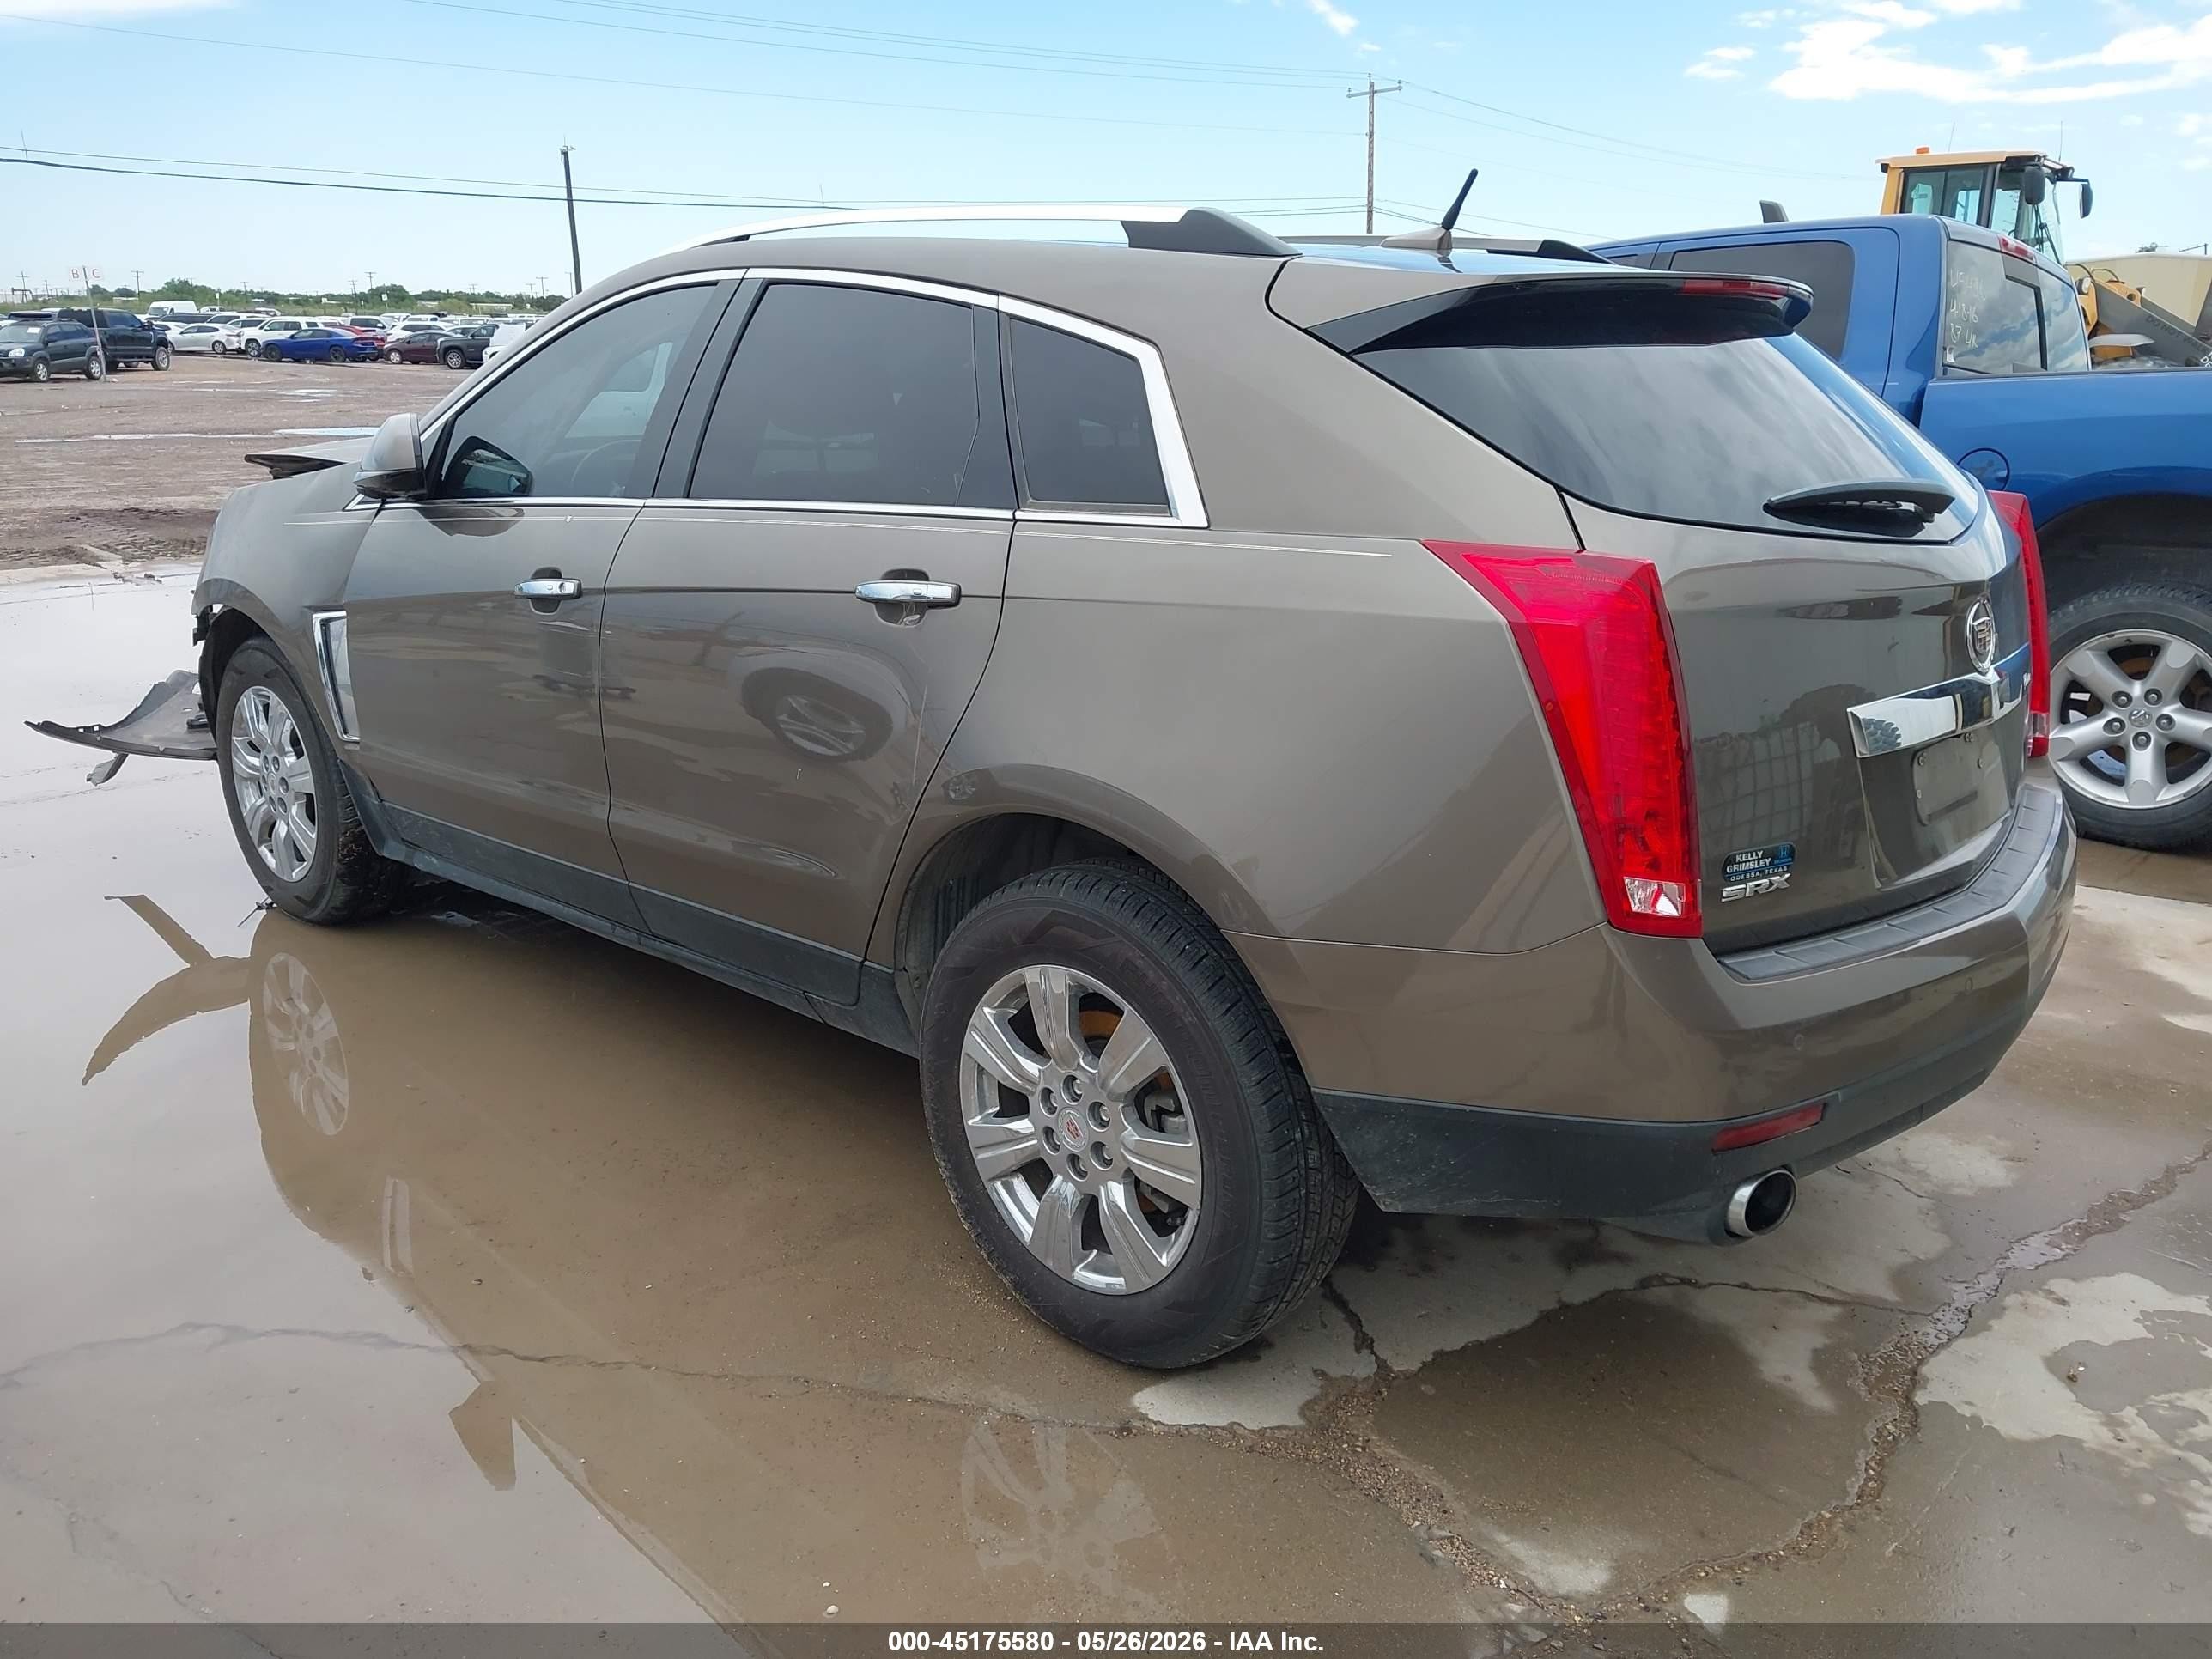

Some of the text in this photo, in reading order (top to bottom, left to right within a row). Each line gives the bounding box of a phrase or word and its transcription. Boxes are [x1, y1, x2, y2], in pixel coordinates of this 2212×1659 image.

[71, 269, 79, 279] B
[92, 268, 101, 279] C
[1736, 851, 1763, 862] KELLY
[1727, 857, 1771, 873] GRIMSLEY
[1765, 866, 1788, 874] TEXAS
[1721, 873, 1790, 902] SRX
